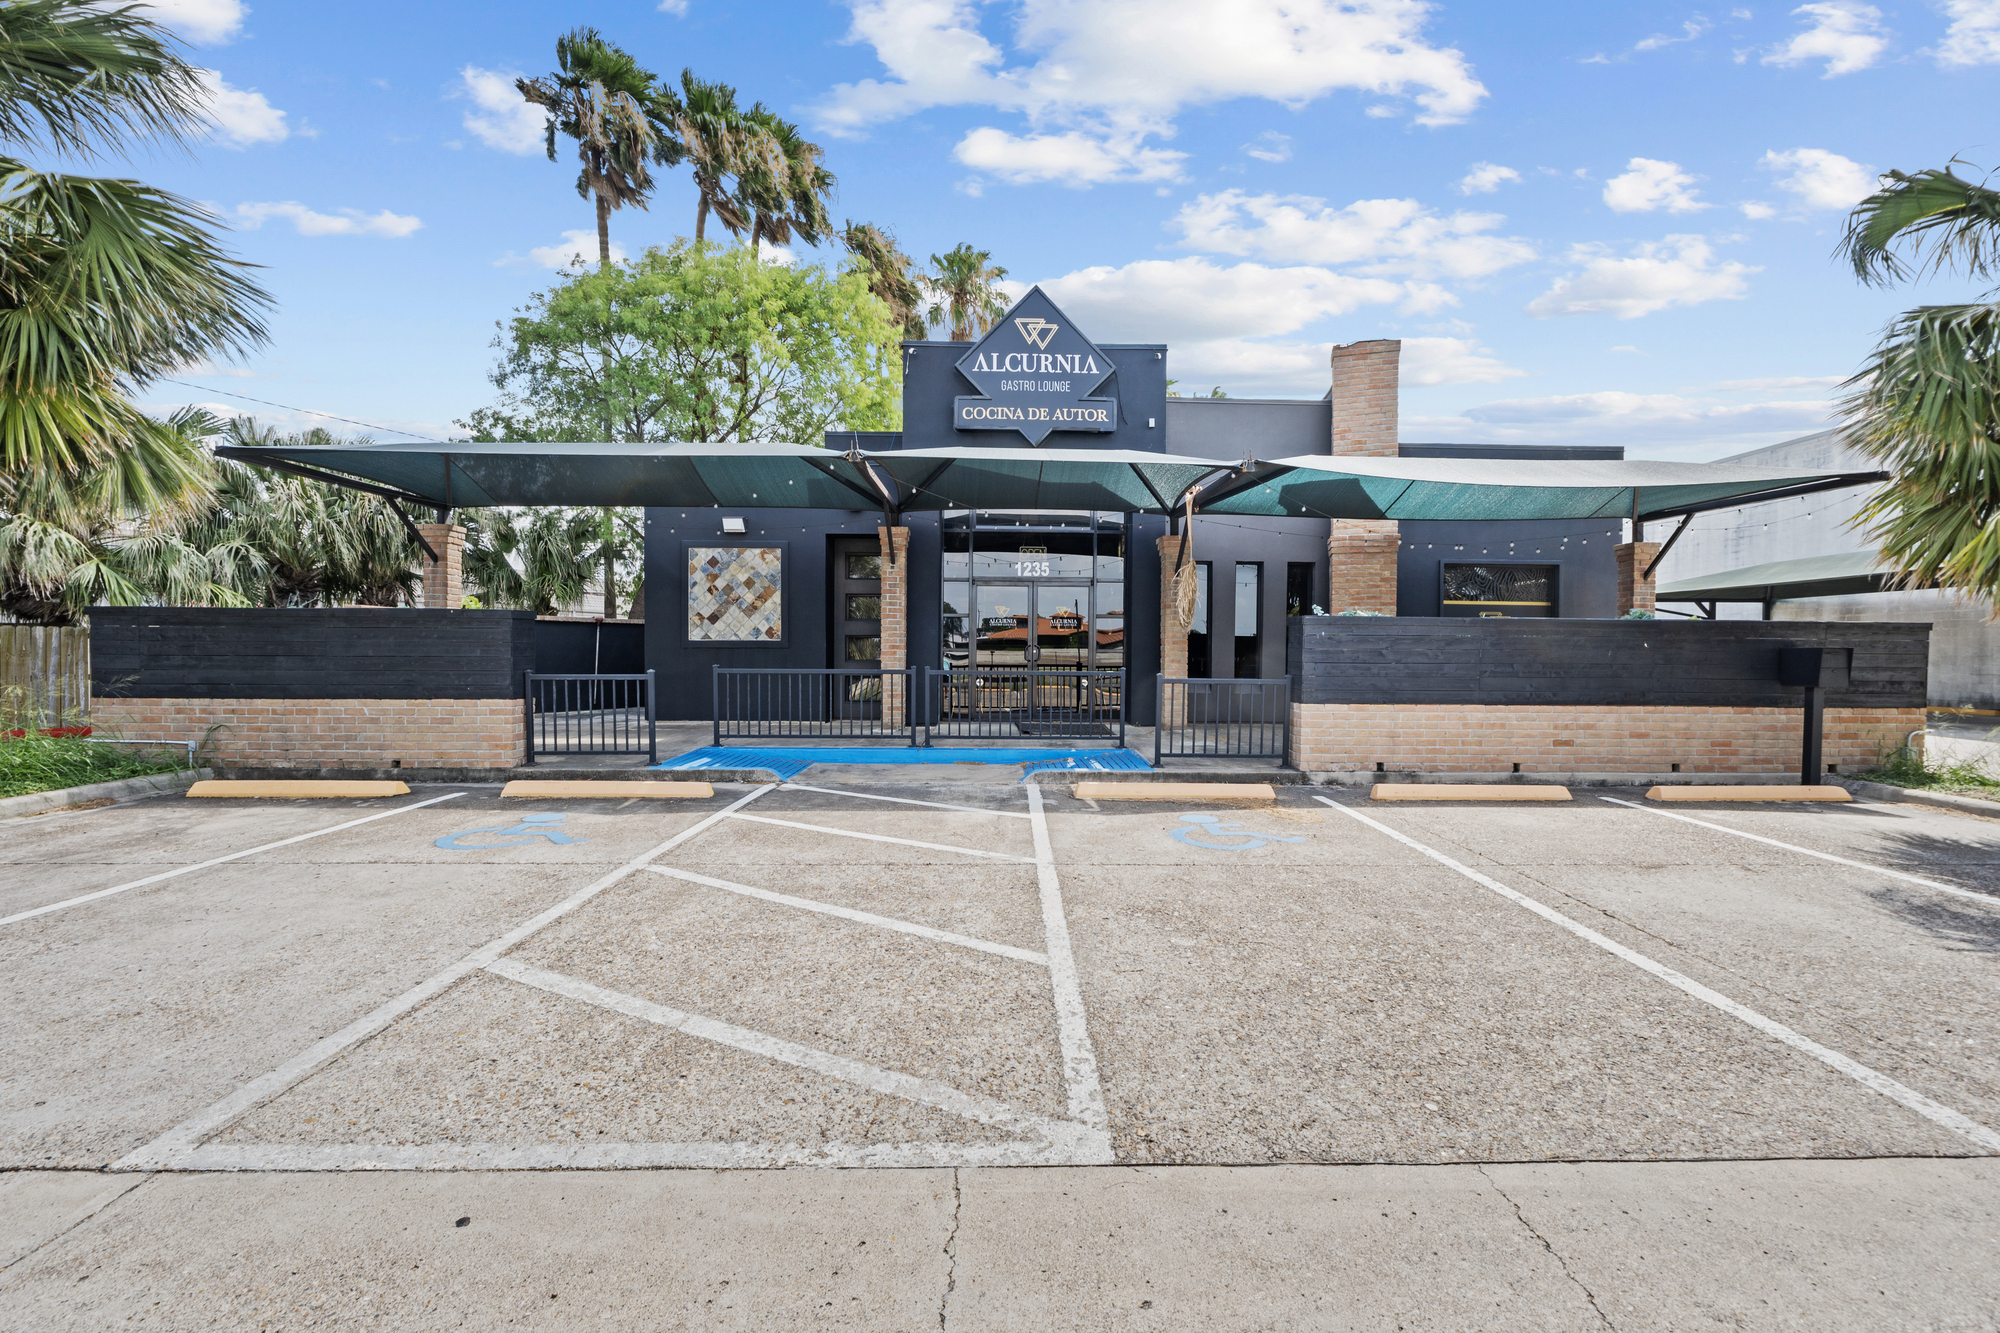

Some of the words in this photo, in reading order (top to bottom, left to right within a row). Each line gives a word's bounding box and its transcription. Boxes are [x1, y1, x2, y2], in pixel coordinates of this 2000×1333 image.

[972, 352, 1100, 374] ALCURNIA
[1001, 380, 1036, 391] GASTRO
[1038, 381, 1071, 392] LOUNGE
[962, 407, 1025, 420] COCINA
[1028, 408, 1050, 420] DE
[1052, 409, 1109, 422] AUTOR
[1021, 548, 1046, 560] OPEN
[1014, 561, 1050, 577] 1235
